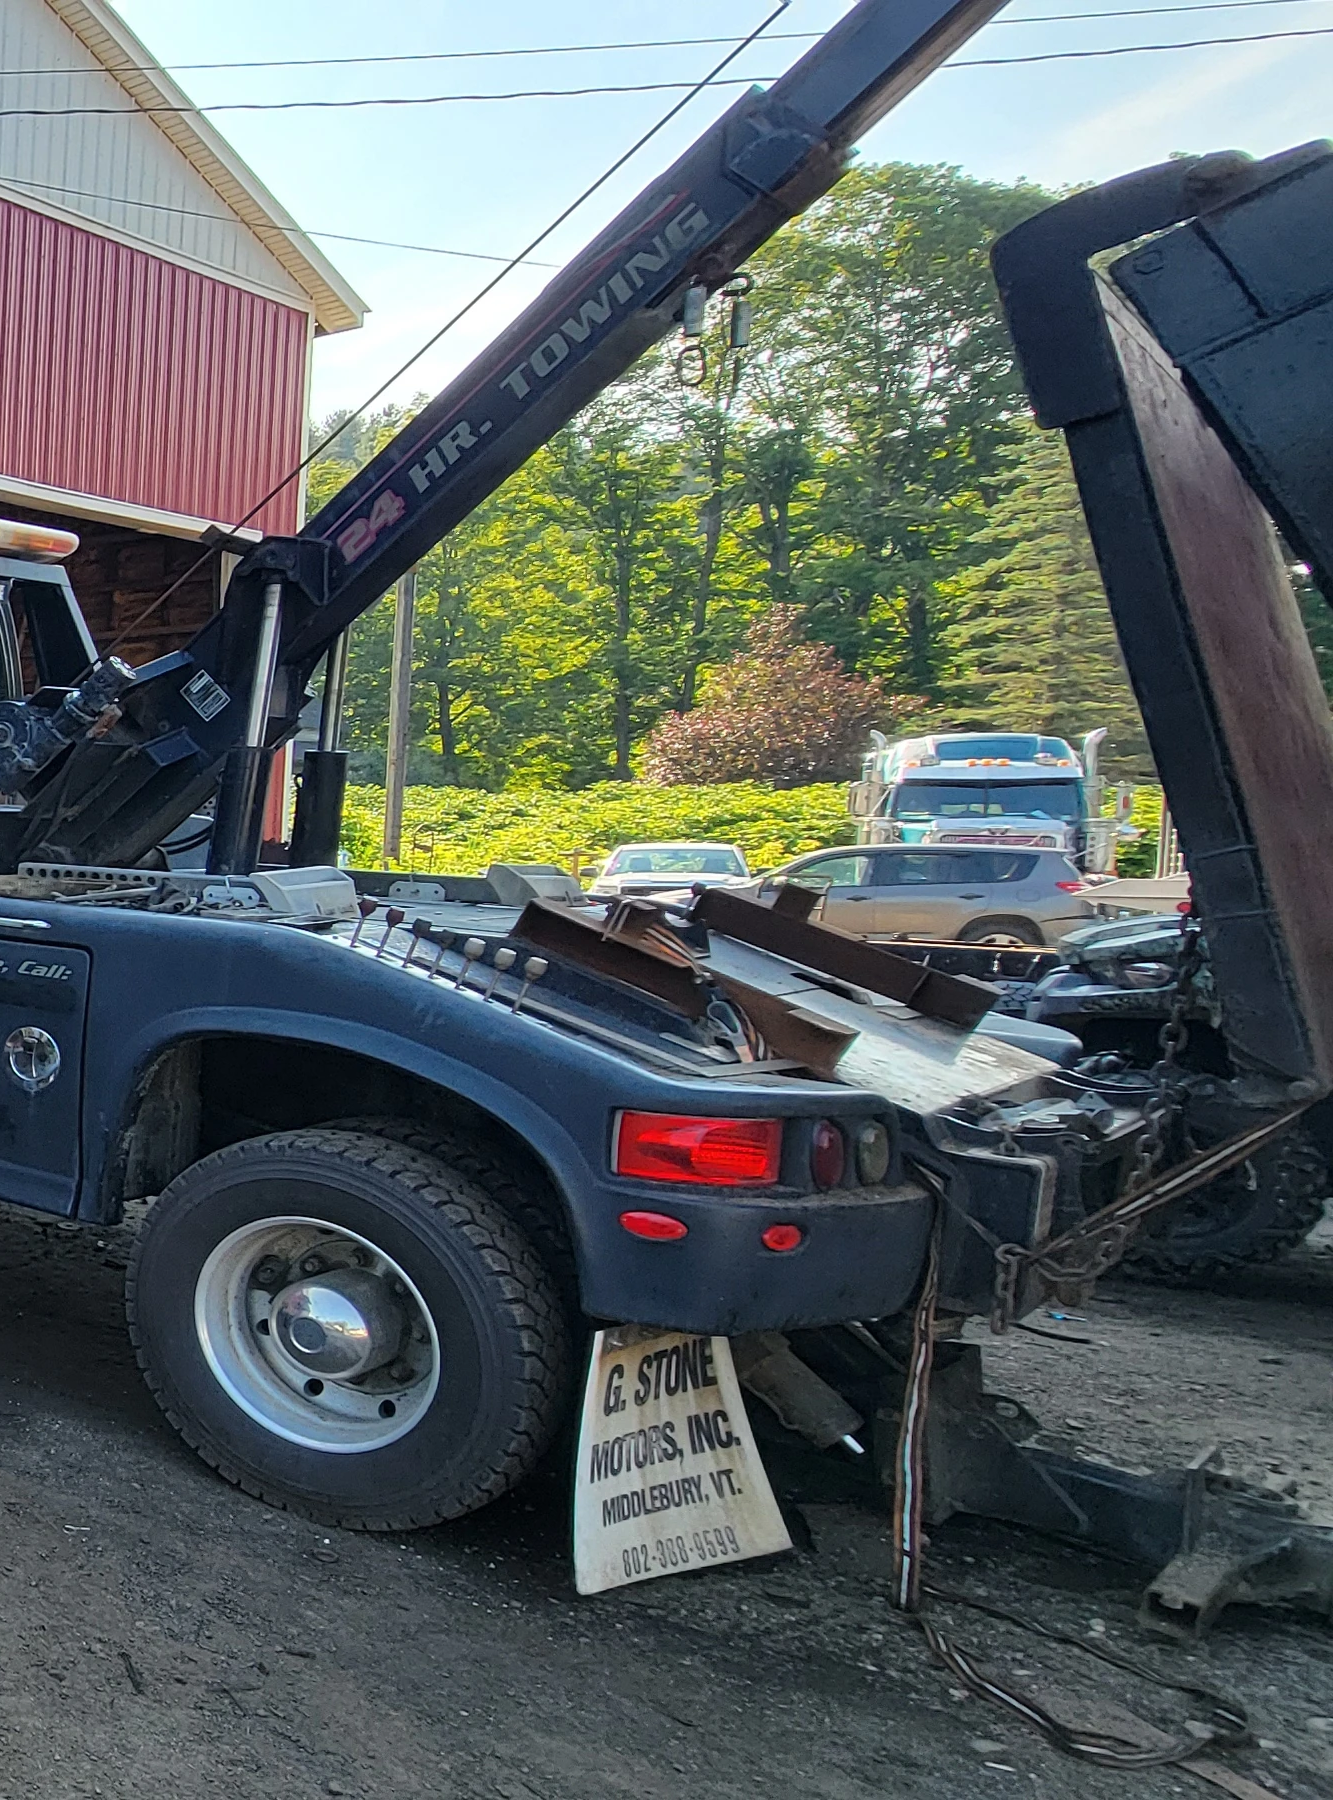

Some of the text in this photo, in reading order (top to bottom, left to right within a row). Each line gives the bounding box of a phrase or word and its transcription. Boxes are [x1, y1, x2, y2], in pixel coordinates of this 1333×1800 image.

[337, 201, 712, 565] 24 HR. TOWING
[17, 960, 73, 980] Call:
[603, 1337, 719, 1416] G. STONE
[589, 1409, 741, 1484] MOTORS, INC.
[602, 1468, 743, 1527] MIDDLEBURY, VT.
